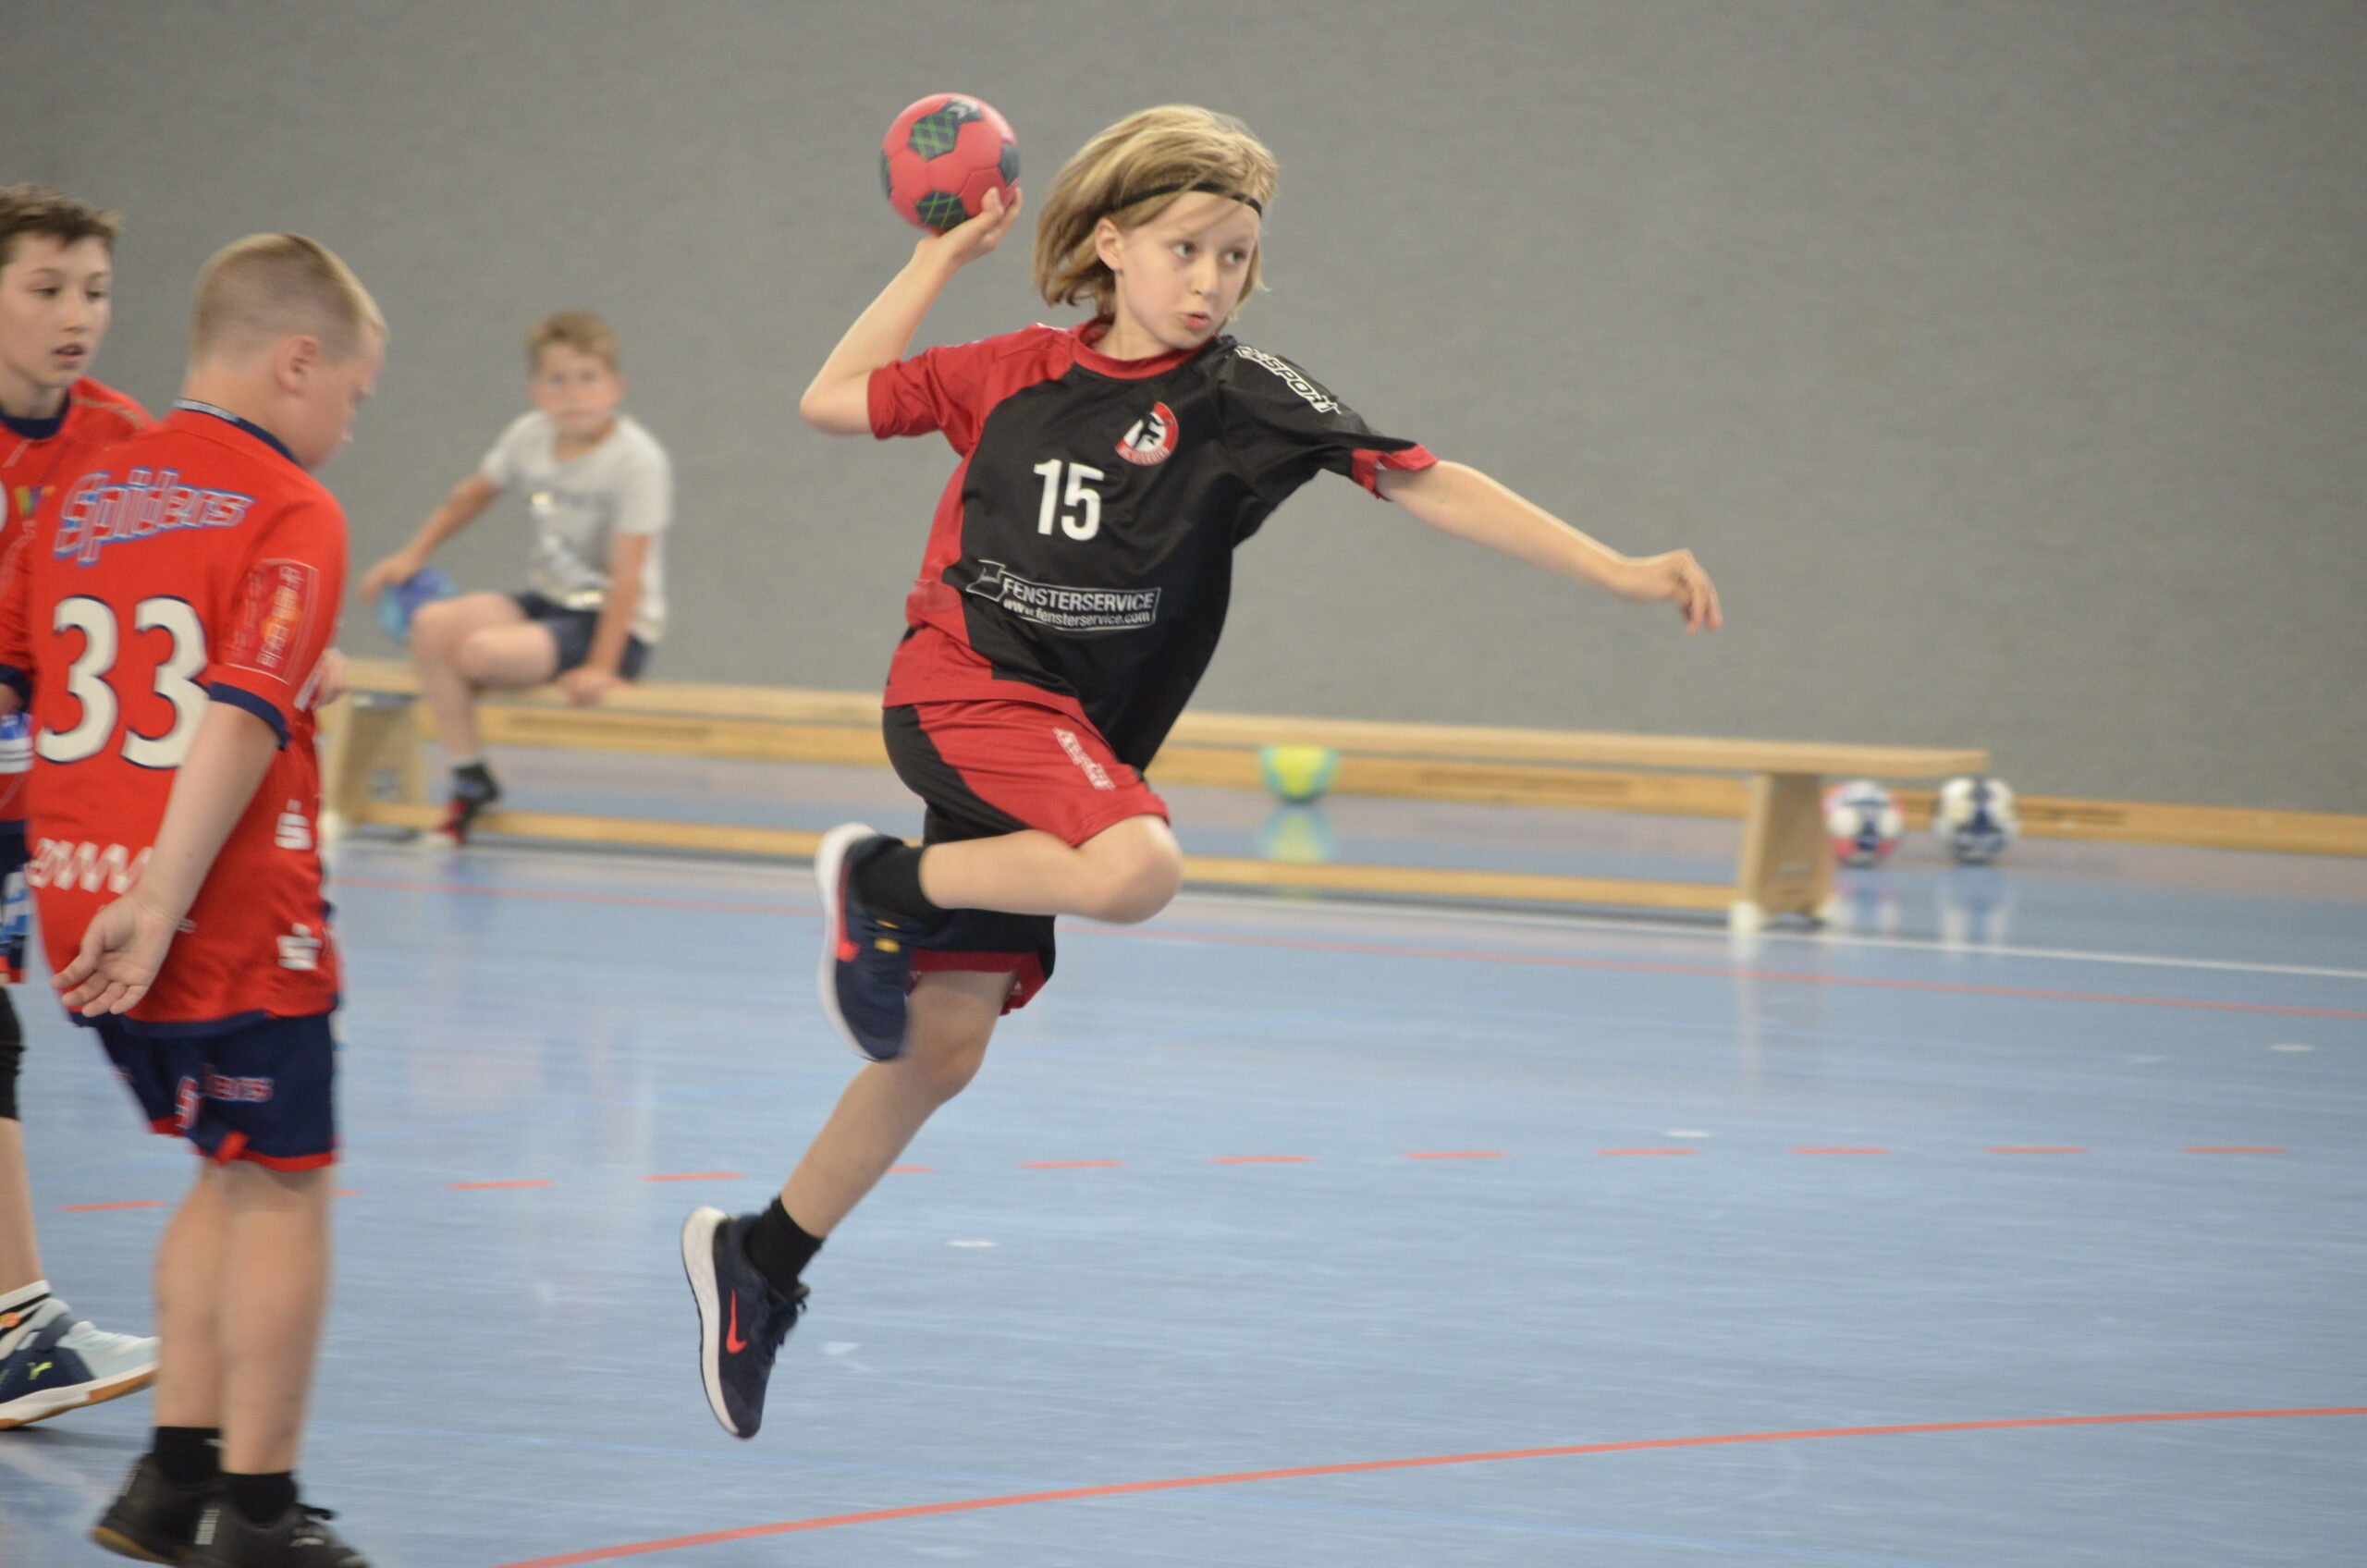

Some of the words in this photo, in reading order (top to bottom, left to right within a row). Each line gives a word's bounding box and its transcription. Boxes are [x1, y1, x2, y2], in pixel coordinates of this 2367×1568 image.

[53, 466, 257, 568] Spiders
[1033, 459, 1105, 541] 15
[1002, 577, 1155, 612] FENSTERSERVICE
[35, 594, 210, 770] 33
